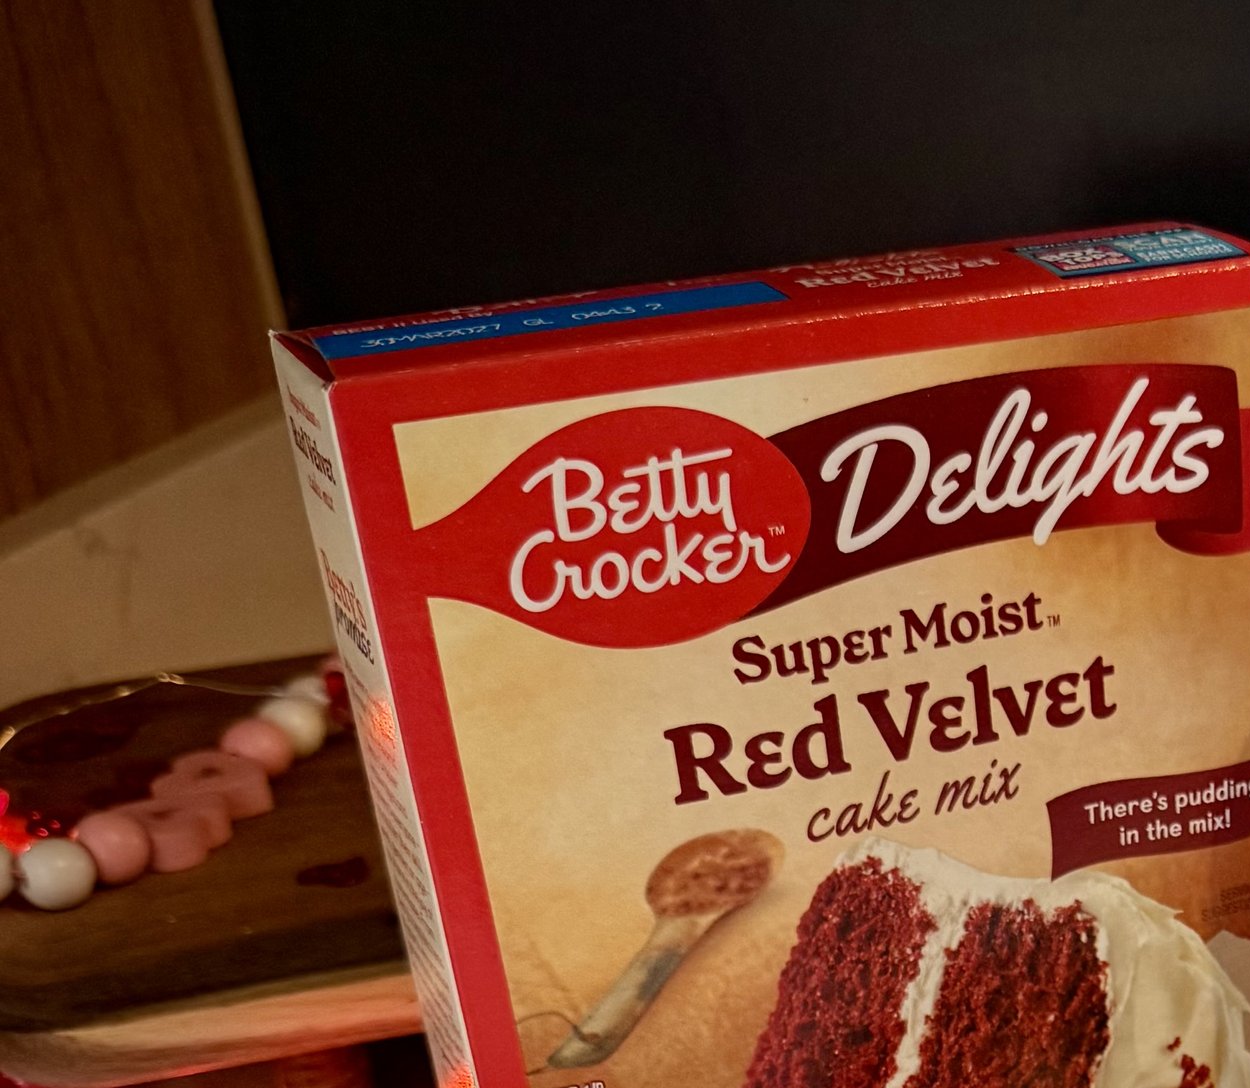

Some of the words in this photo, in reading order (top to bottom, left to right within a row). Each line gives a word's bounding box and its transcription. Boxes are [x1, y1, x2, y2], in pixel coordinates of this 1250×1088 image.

[794, 271, 880, 288] Red
[875, 257, 1000, 277] Velvet
[521, 448, 737, 542] Betty
[821, 377, 1224, 546] Delights
[510, 522, 791, 613] Crocker
[731, 622, 892, 685] Super
[899, 592, 1044, 655] Moist
[663, 693, 852, 805] Red
[857, 655, 1118, 762] Velvet
[805, 770, 921, 843] cake
[933, 758, 1022, 817] mix
[1083, 791, 1169, 825] There's
[1119, 827, 1140, 847] in
[1146, 819, 1183, 842] the
[1188, 807, 1232, 836] mix!
